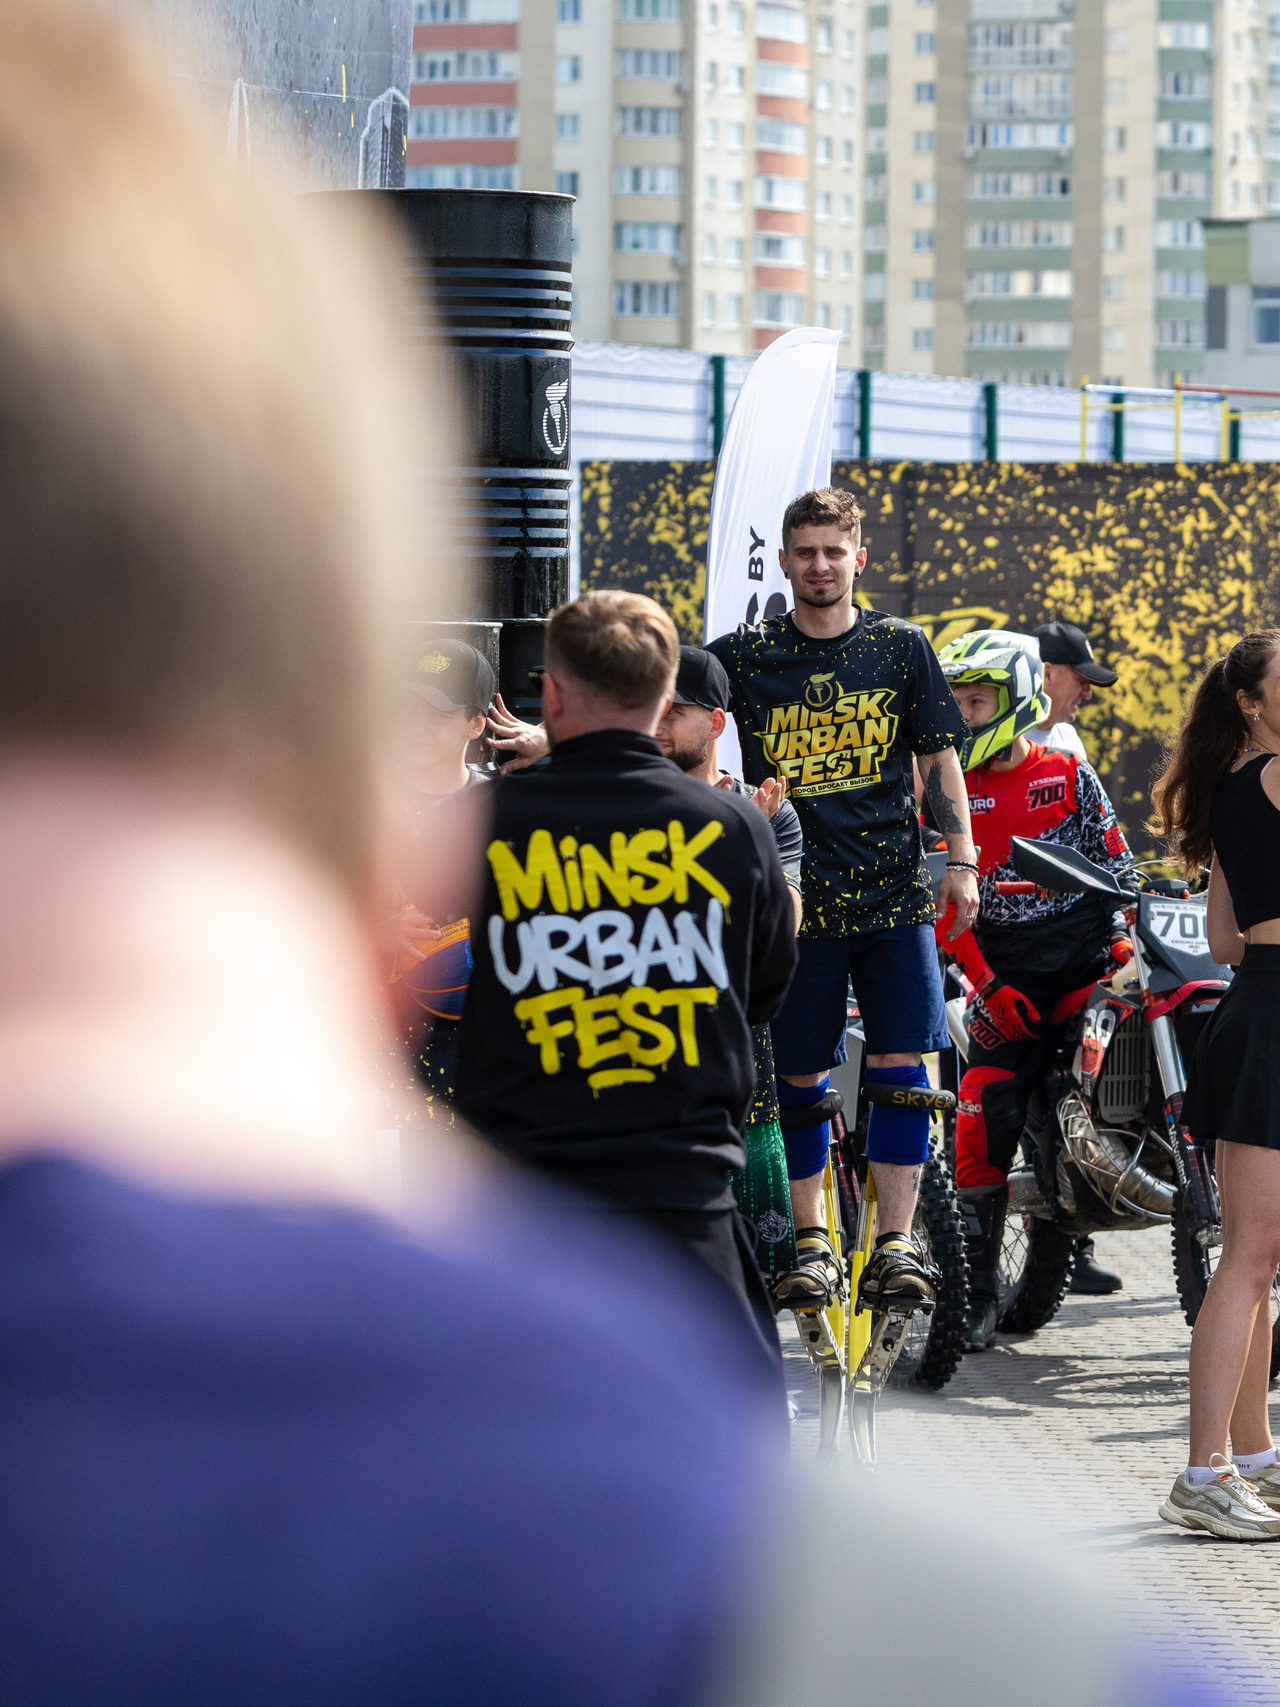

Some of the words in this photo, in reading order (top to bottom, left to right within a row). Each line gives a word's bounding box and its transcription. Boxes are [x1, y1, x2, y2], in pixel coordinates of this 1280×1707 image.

[748, 525, 765, 581] BY
[771, 692, 886, 733] MINSK
[763, 717, 889, 760] URBAN
[777, 745, 878, 785] FEST
[795, 787, 817, 795] ГОРОД
[818, 781, 848, 791] БРОСАЕТ
[850, 777, 875, 786] ВЫЗОВ
[1026, 781, 1067, 811] 700
[1156, 911, 1208, 939] 70
[488, 897, 730, 995] URBAN
[514, 986, 718, 1074] FEST
